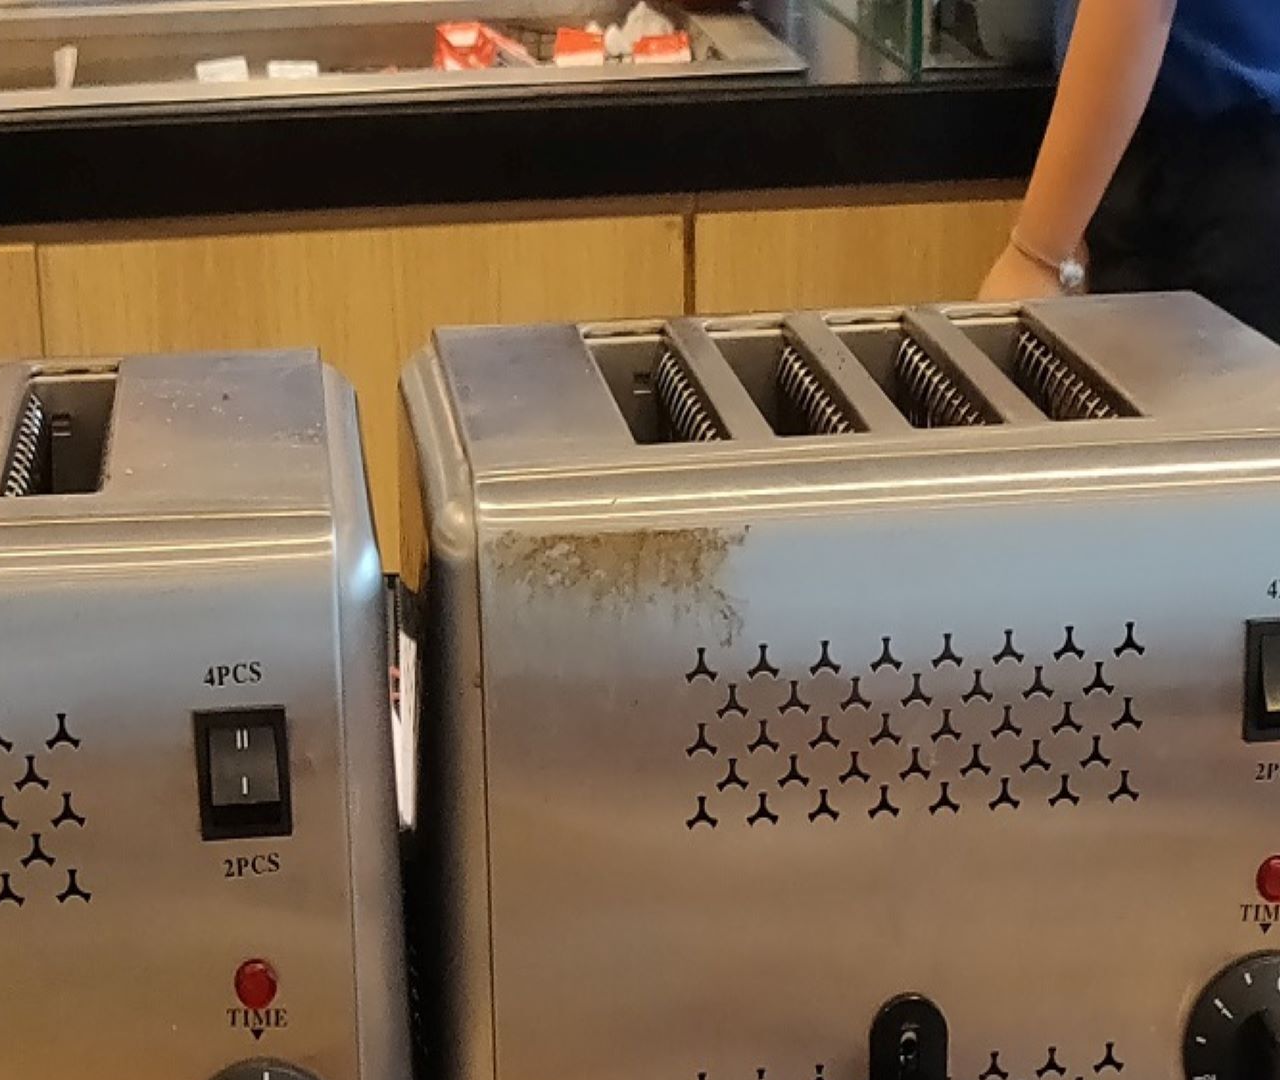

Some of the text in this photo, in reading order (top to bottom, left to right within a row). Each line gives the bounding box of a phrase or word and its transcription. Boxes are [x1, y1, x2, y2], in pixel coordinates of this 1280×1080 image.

[202, 661, 263, 687] 4PCS
[223, 852, 281, 878] 2PCS
[226, 1007, 288, 1028] TIME
